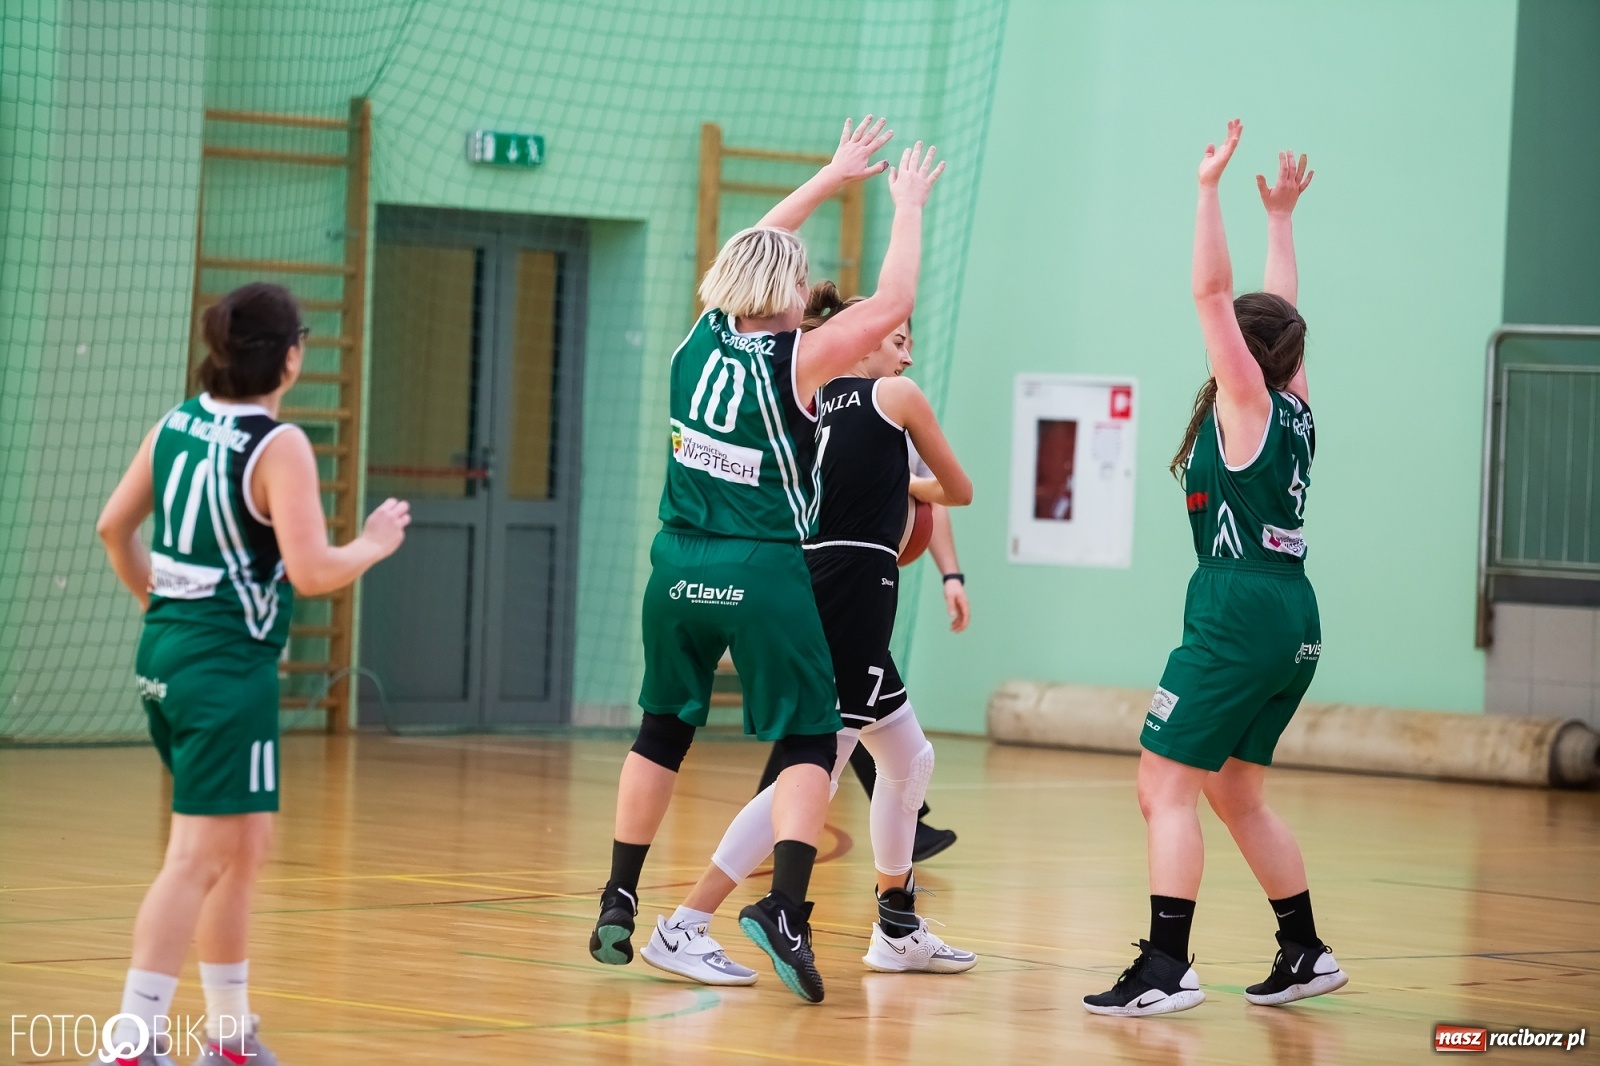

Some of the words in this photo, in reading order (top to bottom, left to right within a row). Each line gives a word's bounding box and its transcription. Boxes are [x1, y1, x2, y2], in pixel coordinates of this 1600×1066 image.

[689, 348, 746, 433] 10
[686, 583, 745, 601] Clavis
[866, 665, 884, 707] 7
[249, 739, 275, 792] 11
